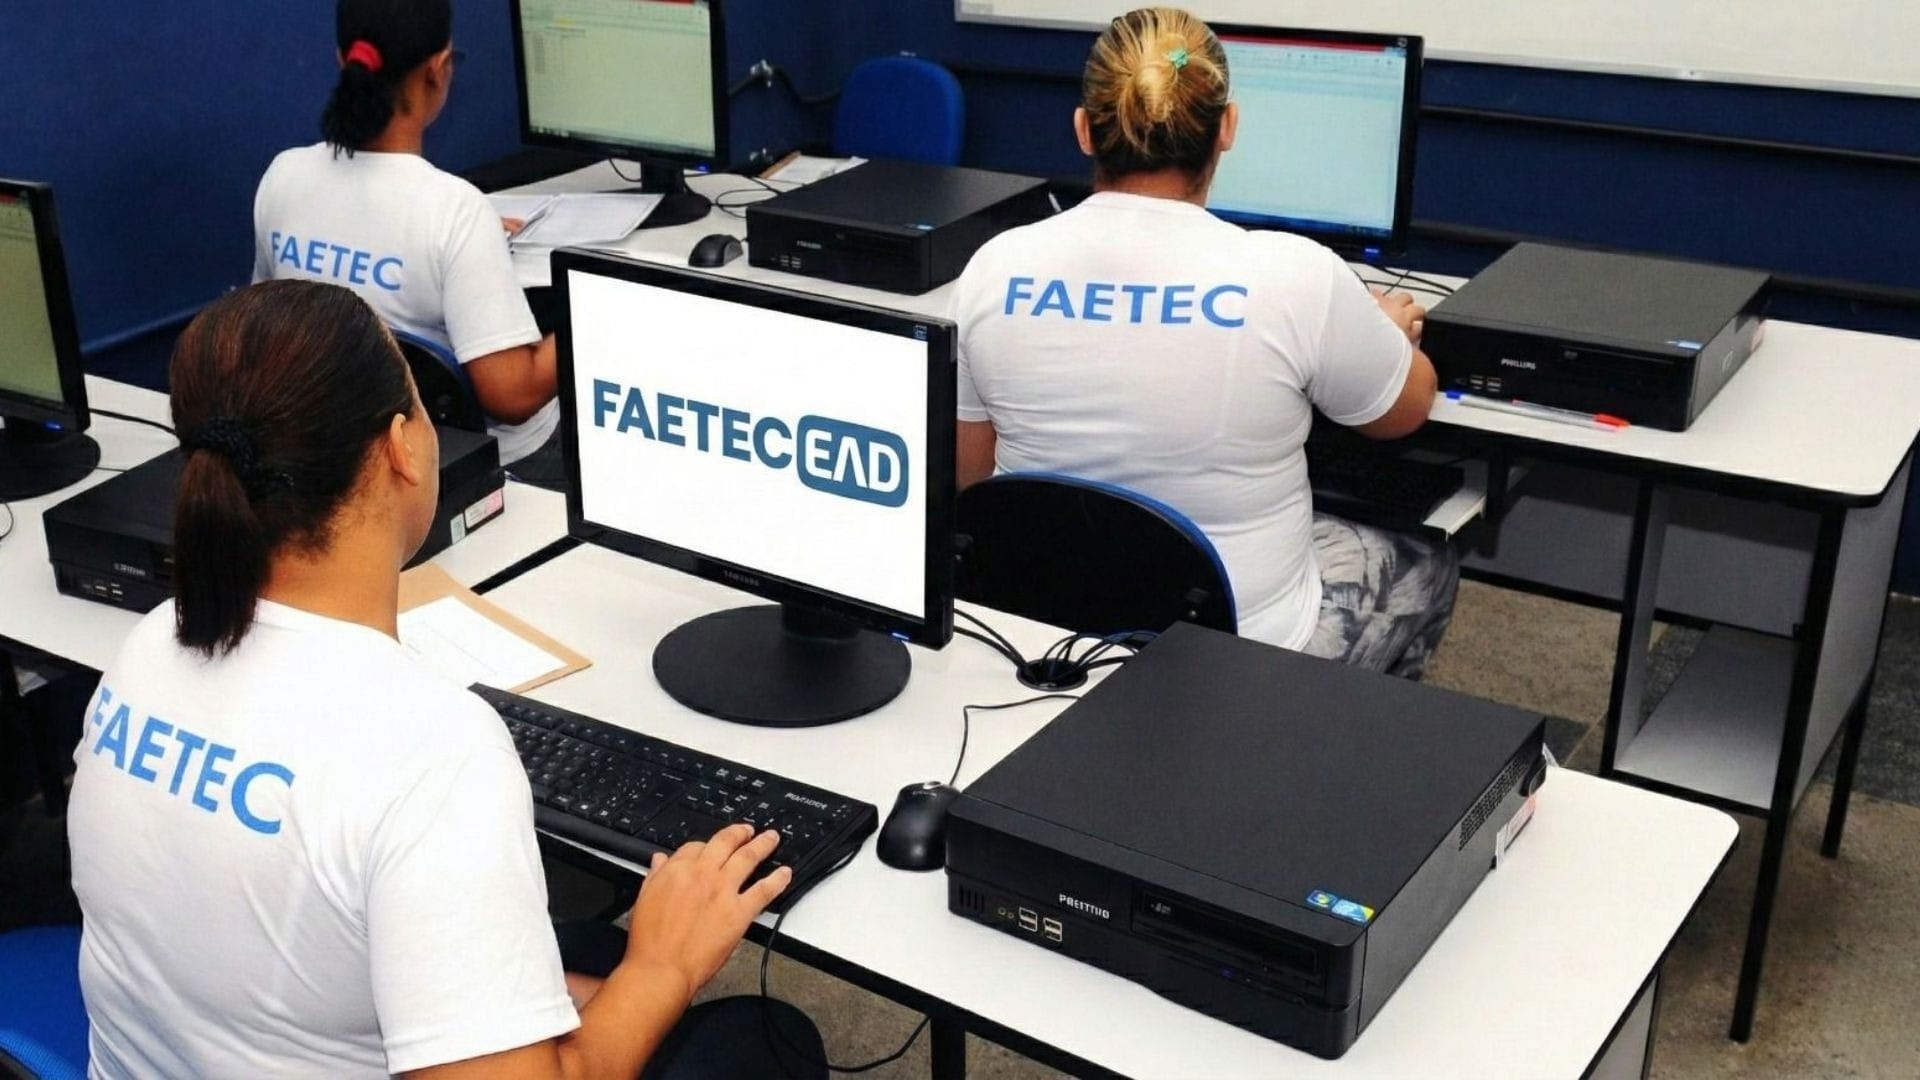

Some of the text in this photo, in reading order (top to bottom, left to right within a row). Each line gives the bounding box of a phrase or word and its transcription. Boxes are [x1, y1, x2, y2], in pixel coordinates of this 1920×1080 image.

[272, 231, 403, 291] FAETEC
[1004, 277, 1248, 328] FAETEC
[593, 378, 900, 493] FAETEC EAD
